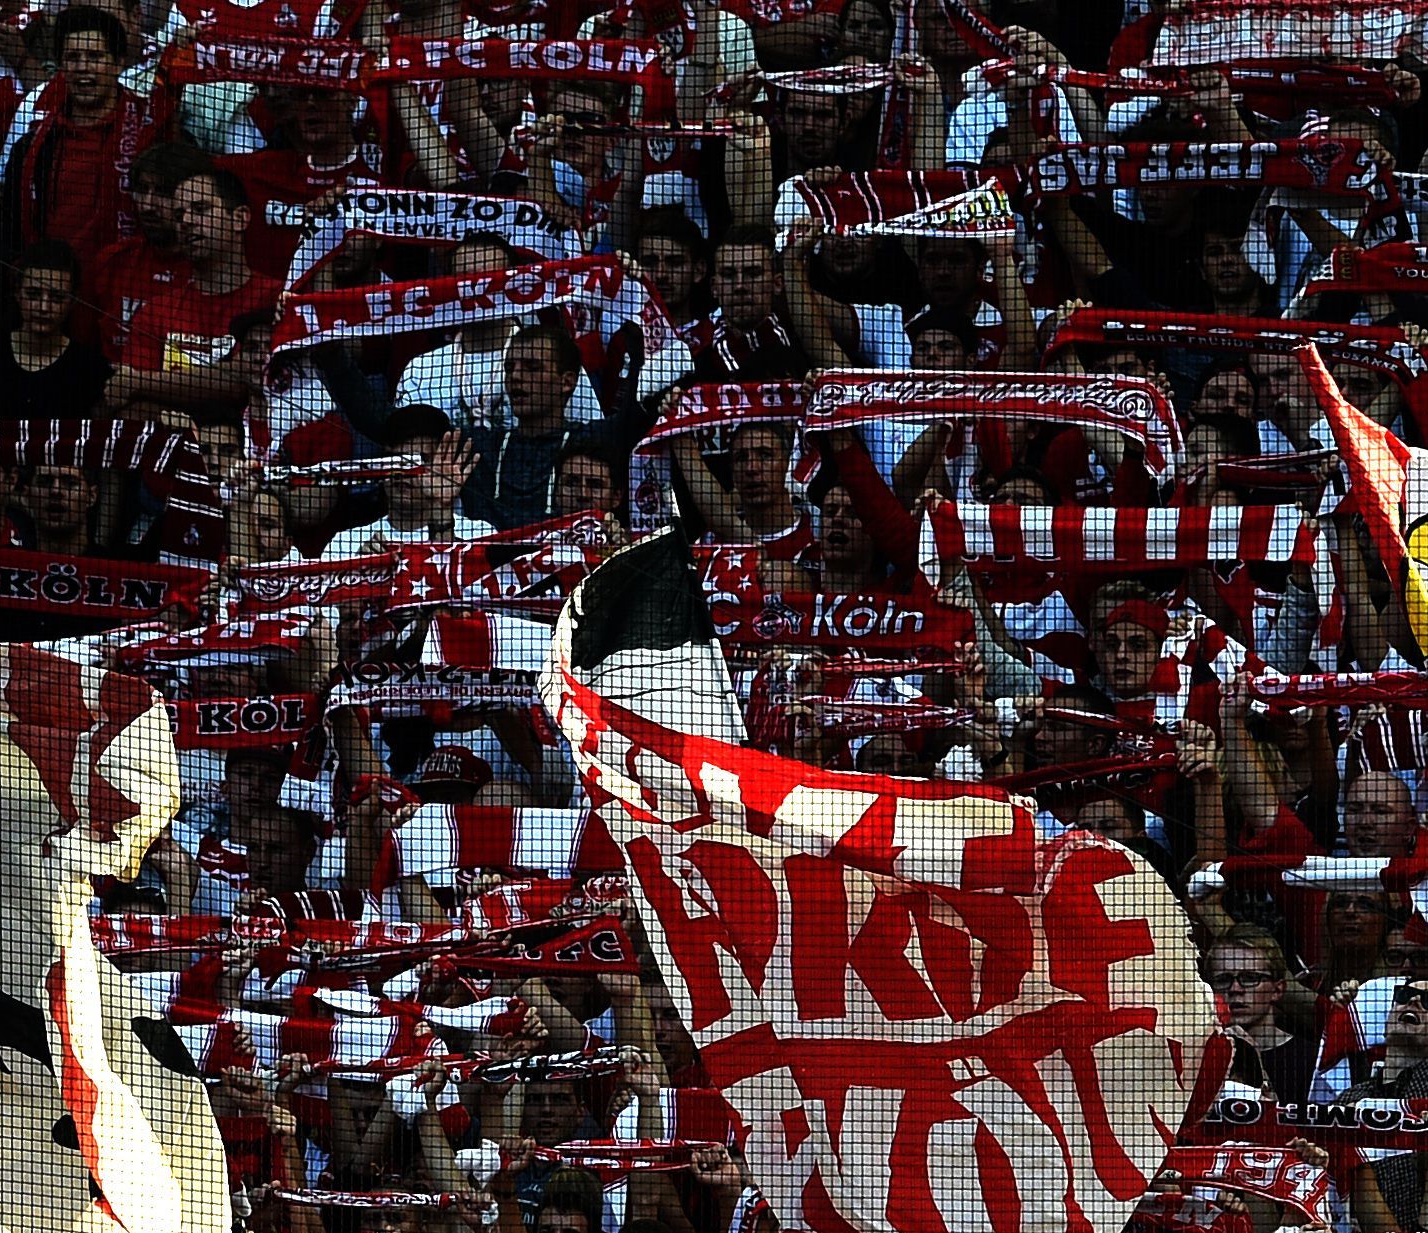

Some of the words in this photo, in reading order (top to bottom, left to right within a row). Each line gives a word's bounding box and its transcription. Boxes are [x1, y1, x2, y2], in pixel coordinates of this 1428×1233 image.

[424, 40, 488, 69] FC
[451, 198, 504, 223] ZO
[295, 303, 347, 333] 1.
[365, 285, 435, 323] FC
[456, 265, 624, 312] KÖLN
[810, 593, 925, 638] Köln
[196, 696, 311, 737] KÖL
